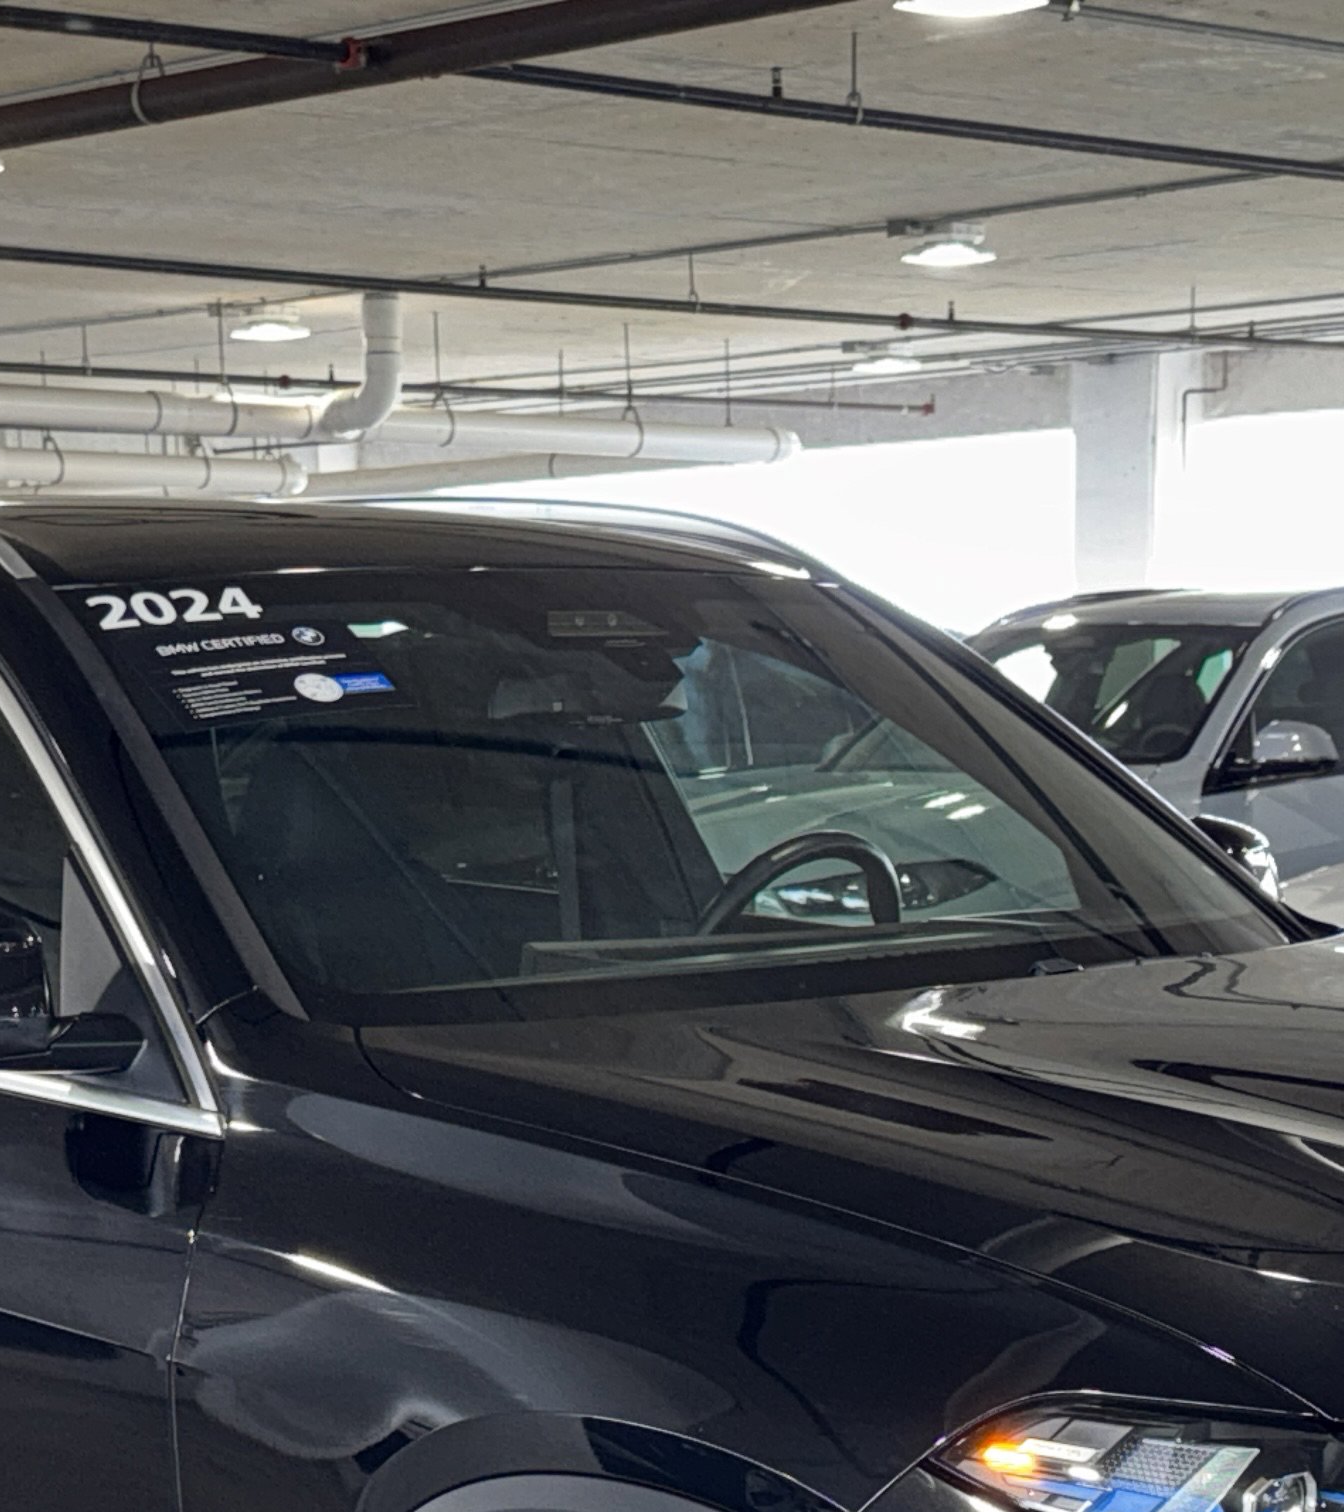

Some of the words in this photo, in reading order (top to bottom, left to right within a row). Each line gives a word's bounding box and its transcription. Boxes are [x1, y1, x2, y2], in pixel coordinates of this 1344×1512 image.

[86, 587, 263, 630] 2024
[156, 641, 200, 657] BMW
[200, 633, 285, 651] CERTIFIED
